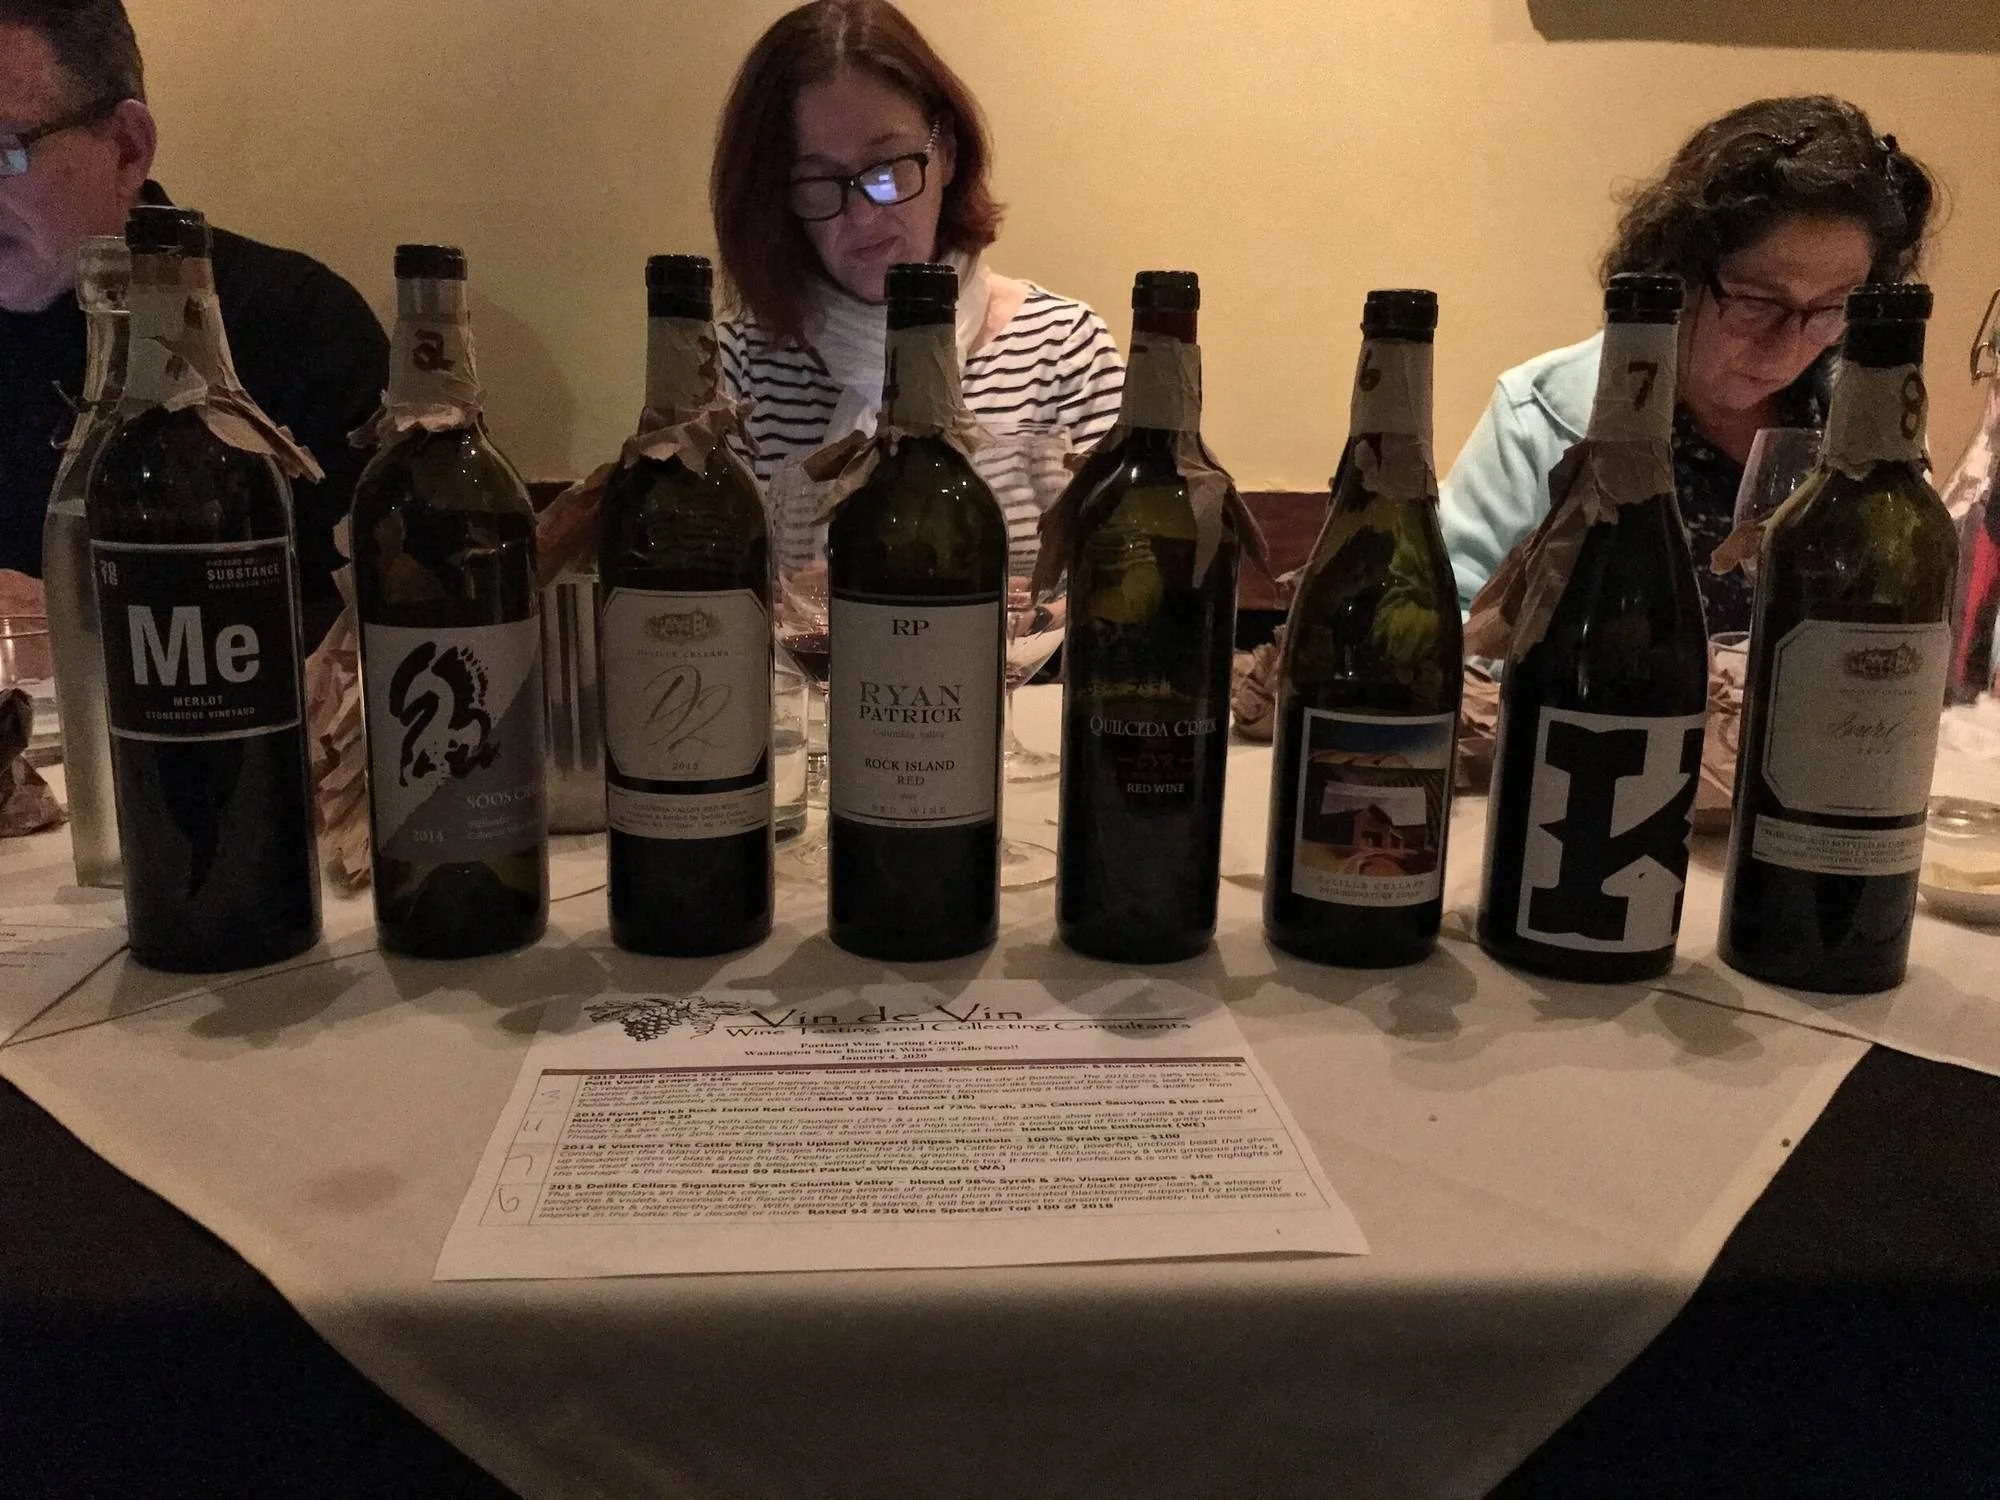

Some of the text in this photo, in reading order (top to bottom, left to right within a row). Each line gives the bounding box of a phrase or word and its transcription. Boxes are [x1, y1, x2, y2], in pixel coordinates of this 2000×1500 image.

[1359, 348, 1381, 391] 6
[1627, 362, 1658, 412] 7
[1900, 372, 1925, 440] 8
[207, 563, 280, 581] SUBSTANCE
[892, 618, 930, 636] RP
[127, 604, 261, 687] Me
[173, 694, 223, 707] MERLOT
[859, 680, 963, 707] RYAN
[208, 706, 255, 719] VINEYARD
[859, 705, 962, 724] PATRICK
[864, 757, 955, 772] ROCK ISLAND
[896, 775, 925, 786] RED
[1127, 783, 1185, 794] RED WINE
[750, 1002, 1022, 1028] Vin de Vin
[726, 1019, 1190, 1037] Wine Tasting and Collecting Consultants
[744, 1049, 810, 1057] Washington
[800, 1041, 848, 1049] Portland
[852, 1040, 880, 1048] Wine
[928, 1039, 964, 1047] Group
[681, 1181, 744, 1189] Signature
[940, 1205, 1002, 1213] Spectator
